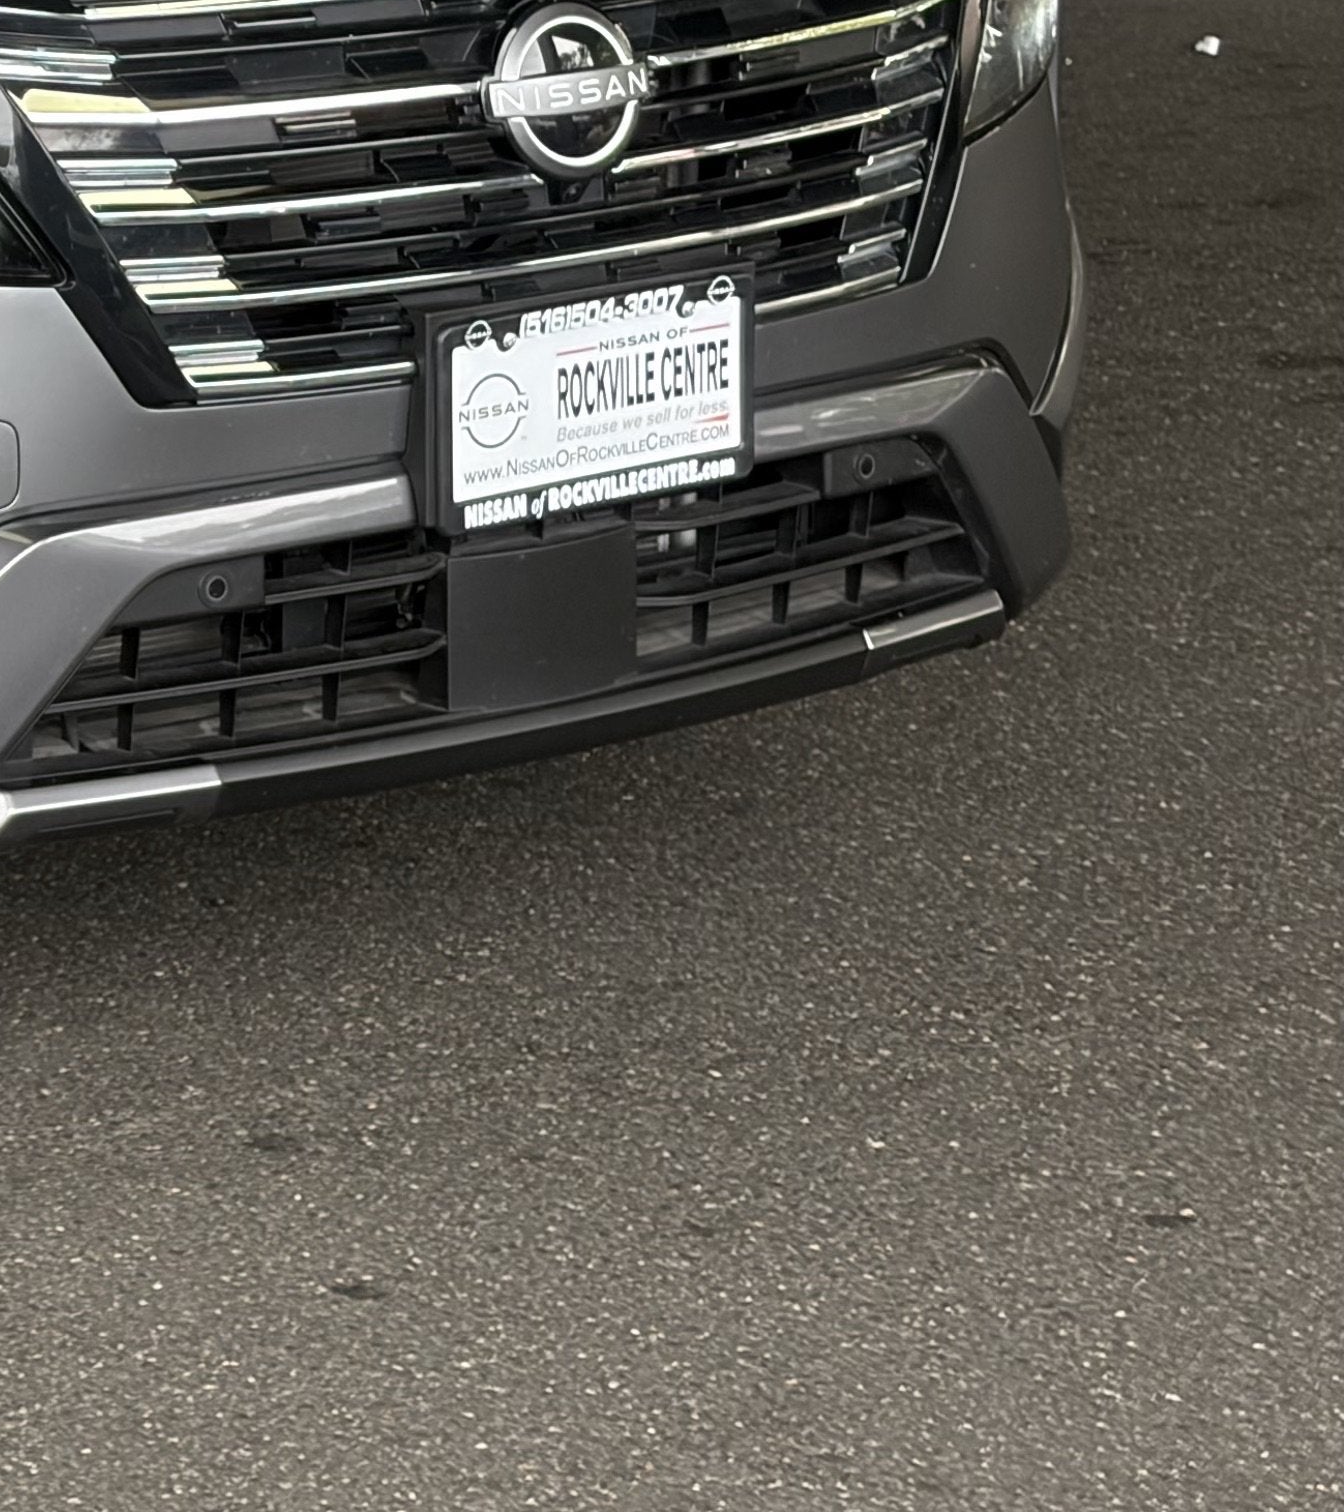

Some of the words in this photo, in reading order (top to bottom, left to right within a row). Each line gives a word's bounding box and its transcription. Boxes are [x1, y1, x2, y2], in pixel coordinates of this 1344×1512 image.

[497, 67, 648, 115] NISSAN
[599, 331, 660, 352] NISSAN
[666, 327, 690, 340] OF
[557, 352, 656, 419] ROCKVILLE
[662, 339, 729, 400] CENTRE
[459, 399, 529, 423] NISSAN
[557, 418, 618, 442] Because
[622, 416, 643, 430] we
[647, 410, 672, 426] sell
[675, 404, 693, 420] for
[464, 493, 528, 530] NISSAN
[531, 490, 546, 519] of
